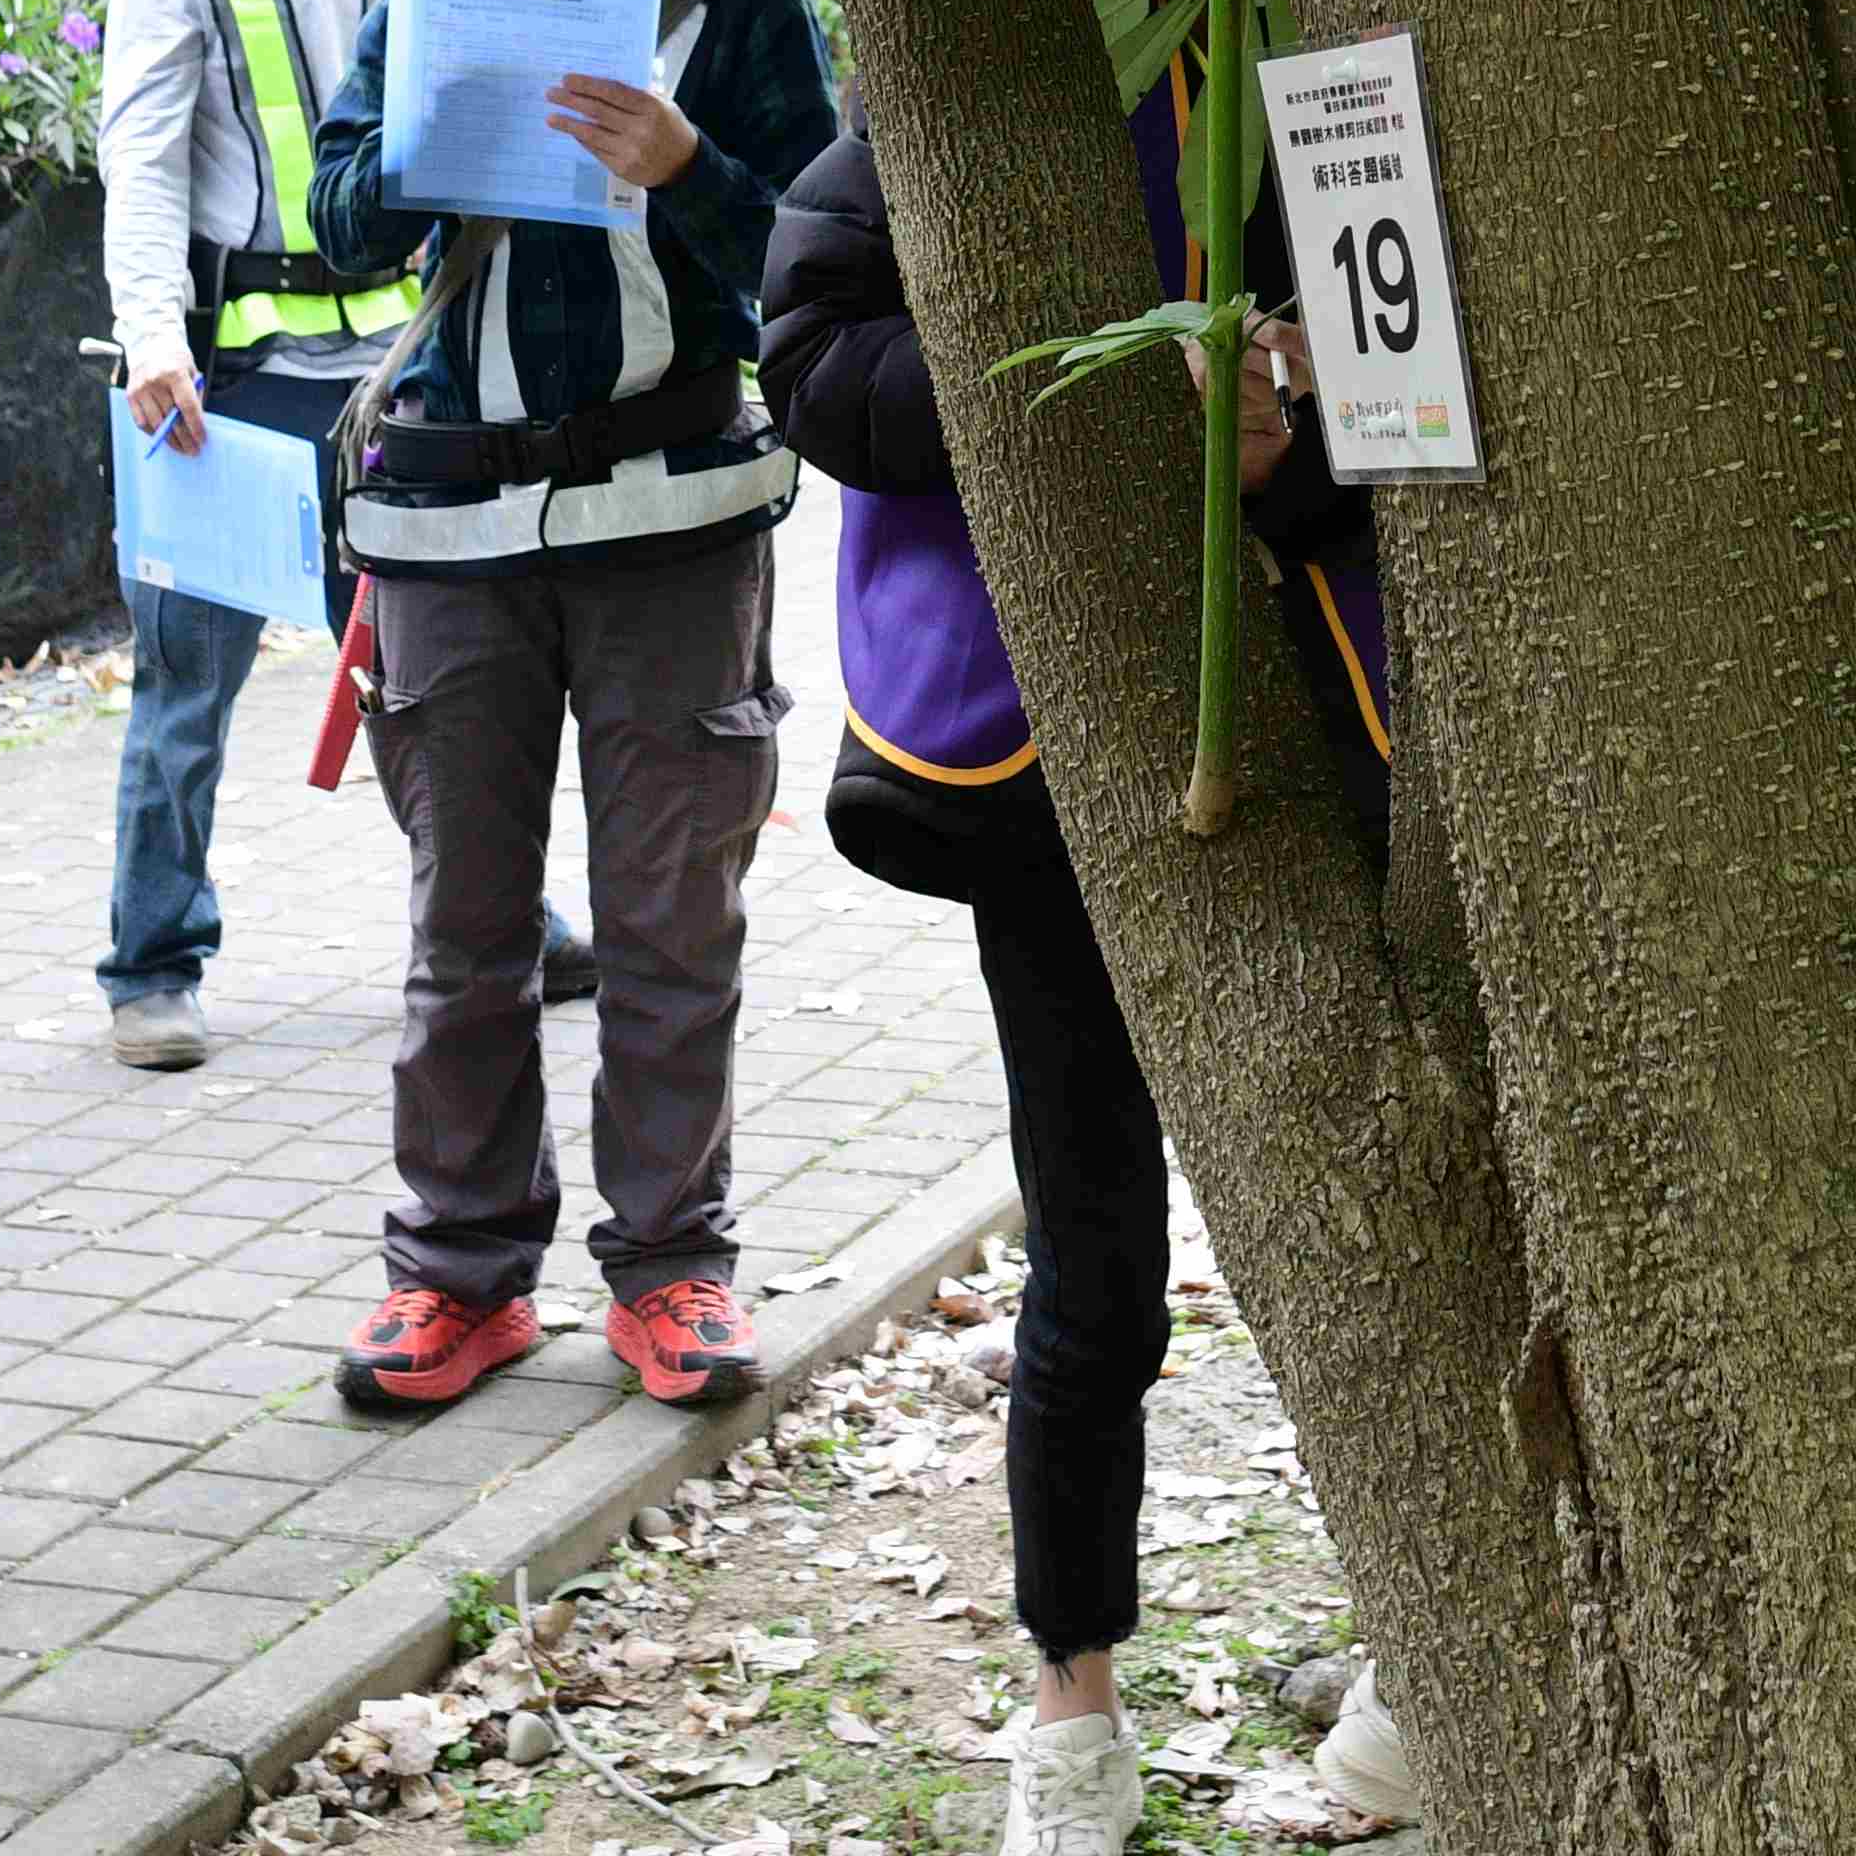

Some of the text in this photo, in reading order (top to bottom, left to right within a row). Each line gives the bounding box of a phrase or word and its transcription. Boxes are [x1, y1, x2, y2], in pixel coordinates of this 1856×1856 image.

[1312, 152, 1404, 192] 術科答題編號
[1333, 217, 1420, 355] 19
